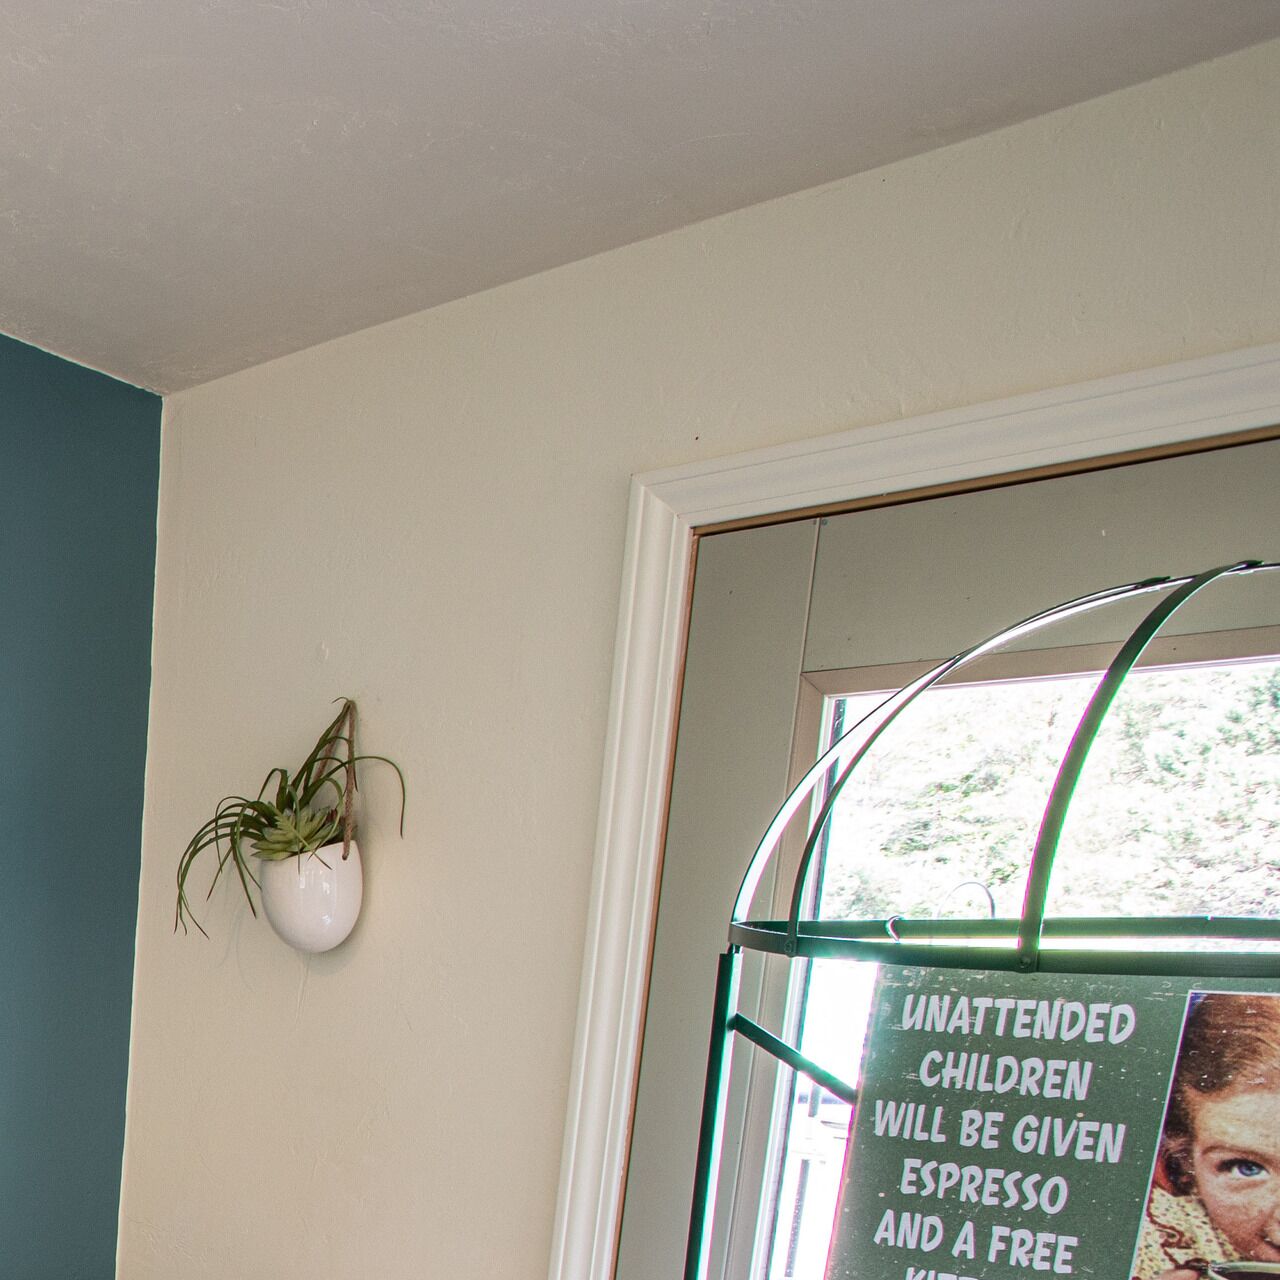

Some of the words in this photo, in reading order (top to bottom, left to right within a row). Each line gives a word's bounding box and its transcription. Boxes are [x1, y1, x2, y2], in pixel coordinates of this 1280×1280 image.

[902, 994, 1136, 1045] UNATTENDED
[919, 1050, 1093, 1101] CHILDREN
[873, 1100, 947, 1143] WILL
[960, 1108, 1005, 1150] BE
[1012, 1114, 1126, 1164] GIVEN
[900, 1158, 1069, 1215] ESPRESSO
[873, 1208, 944, 1252] AND
[951, 1221, 976, 1260] A
[987, 1225, 1080, 1274] FREE
